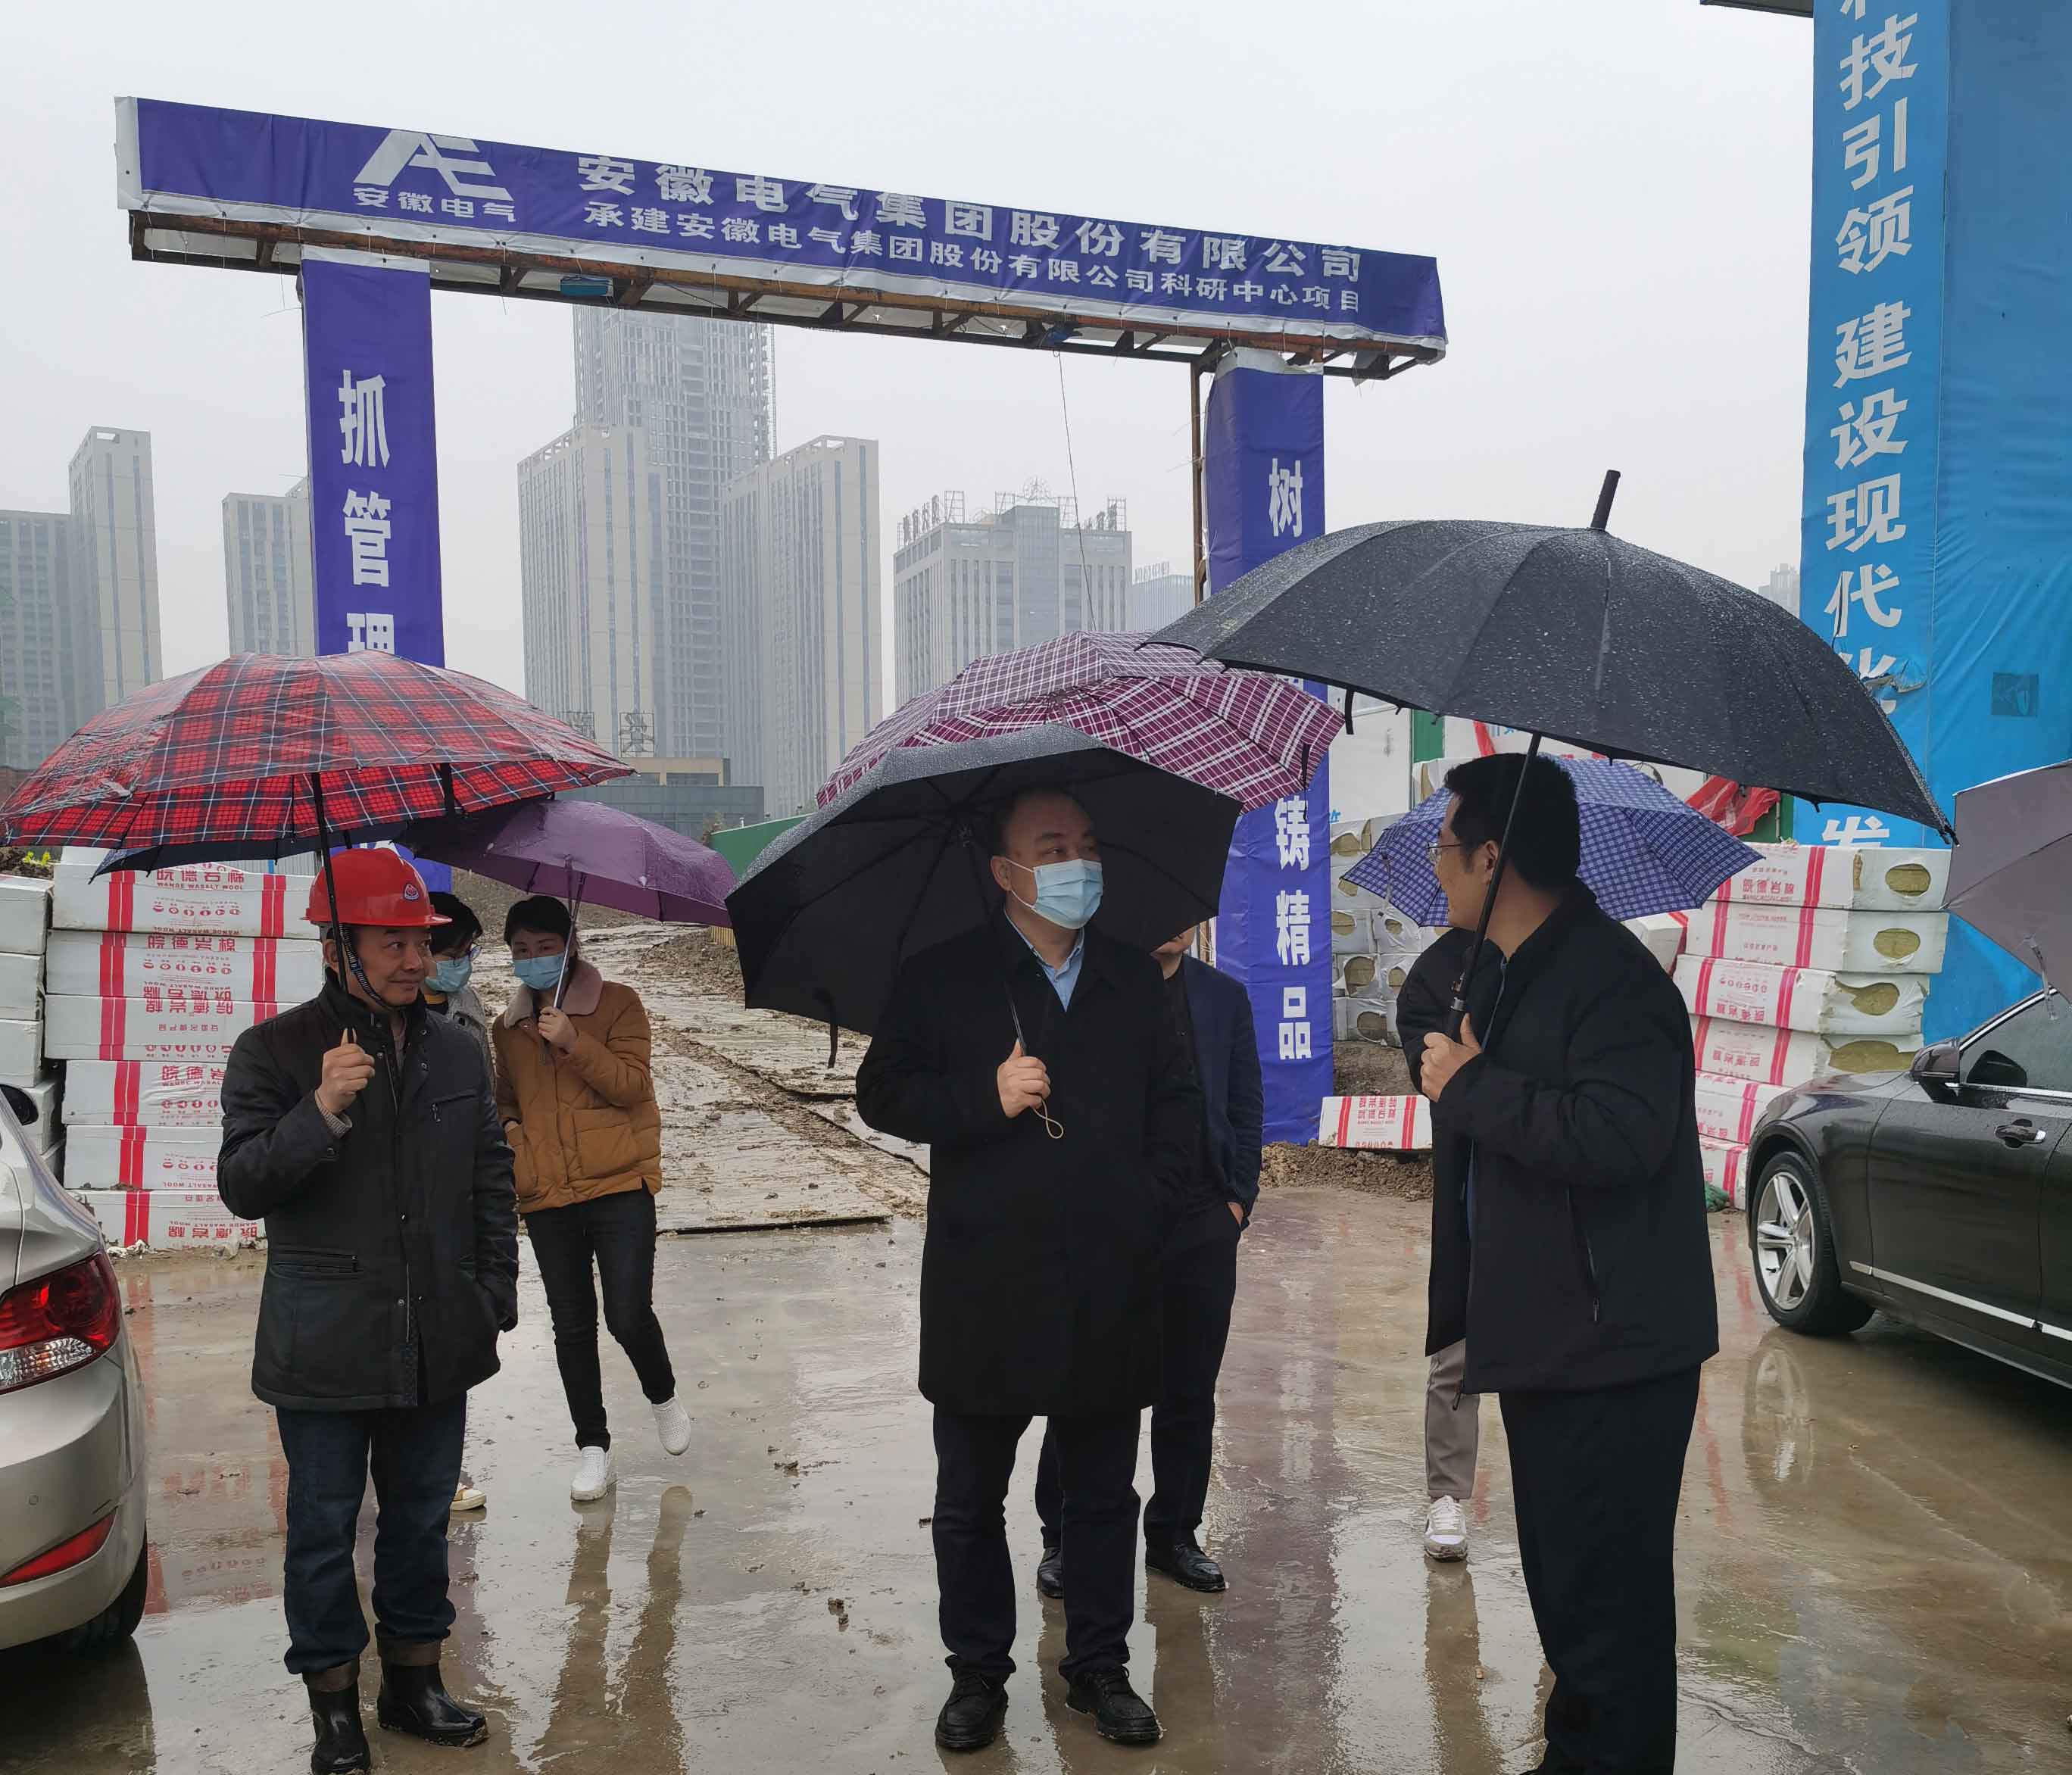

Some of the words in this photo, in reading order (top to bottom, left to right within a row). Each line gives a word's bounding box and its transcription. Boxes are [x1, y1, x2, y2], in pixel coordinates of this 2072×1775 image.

[1836, 0, 1918, 274] 技引领
[353, 188, 516, 223] 安徽电气
[578, 156, 1362, 282] 安徽电气集团股份有限公司
[584, 201, 1359, 312] 承建安徽电气集团股份有限公司科研中心项目
[1269, 457, 1303, 537] 树
[1274, 795, 1312, 1060] 铸精品
